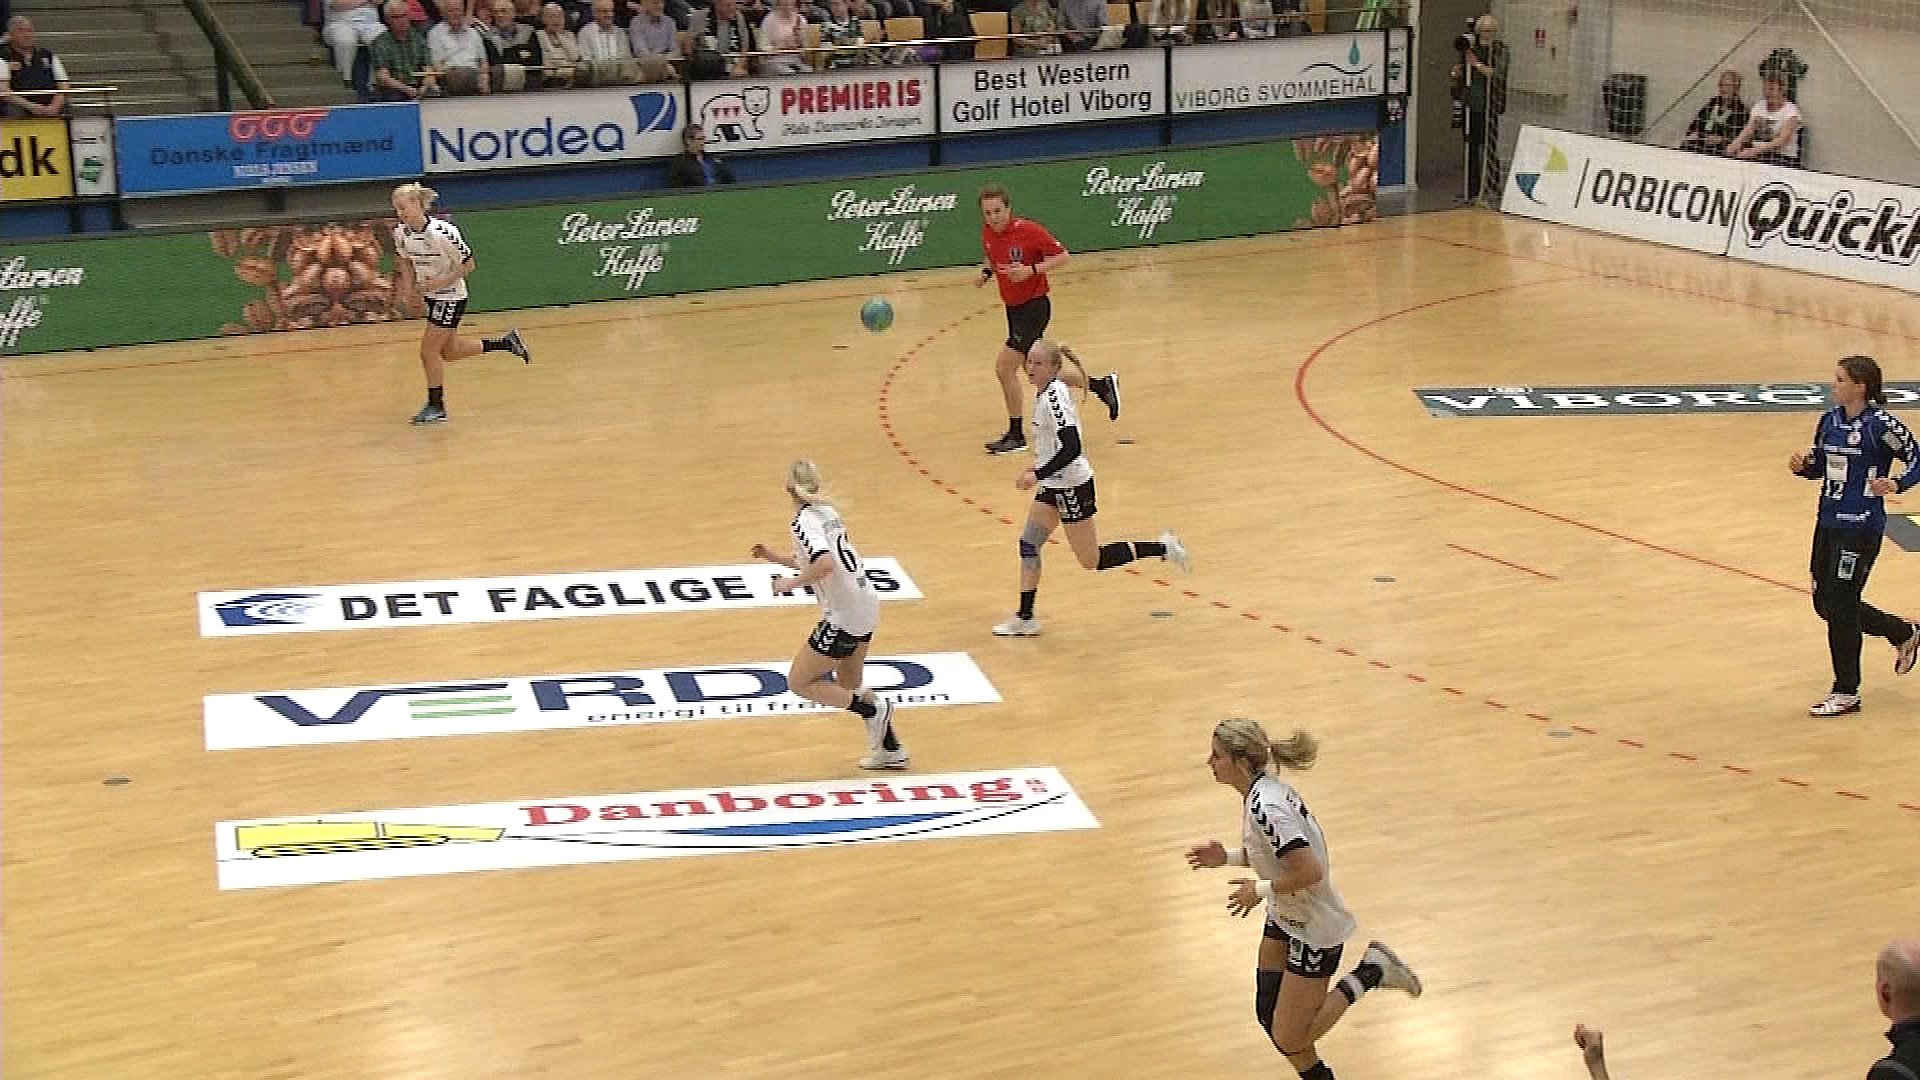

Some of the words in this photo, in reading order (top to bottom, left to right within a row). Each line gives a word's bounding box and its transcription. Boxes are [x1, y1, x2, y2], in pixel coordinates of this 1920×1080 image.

[974, 67, 1027, 92] Best
[1038, 62, 1130, 86] Western
[780, 82, 891, 116] PREMIER
[897, 79, 921, 107] IS
[952, 97, 1000, 123] Golf
[1011, 91, 1070, 118] Hotel
[1080, 89, 1152, 112] Viborg
[1175, 86, 1250, 109] VIBORG
[0, 135, 59, 178] dk
[150, 146, 244, 166] Danske
[429, 115, 625, 165] Nordea
[1082, 167, 1140, 196] Peter
[1136, 161, 1206, 191] Larsen
[1592, 167, 1738, 227] ORBICON
[827, 189, 889, 221] Peter
[884, 184, 958, 214] Larsen
[1111, 195, 1173, 239] Kaffe
[557, 212, 625, 244] Peter
[621, 207, 700, 239] Larsen
[859, 220, 924, 265] Kaffe
[592, 243, 665, 290] Kaffe
[1424, 388, 1826, 411] VIBORG
[1824, 479, 1845, 501] 12
[837, 530, 858, 573] 6
[340, 591, 459, 621] DET
[487, 575, 755, 613] FAGLIGE
[587, 706, 705, 723] energi
[720, 702, 753, 715] til
[519, 777, 1023, 827] Danboring
